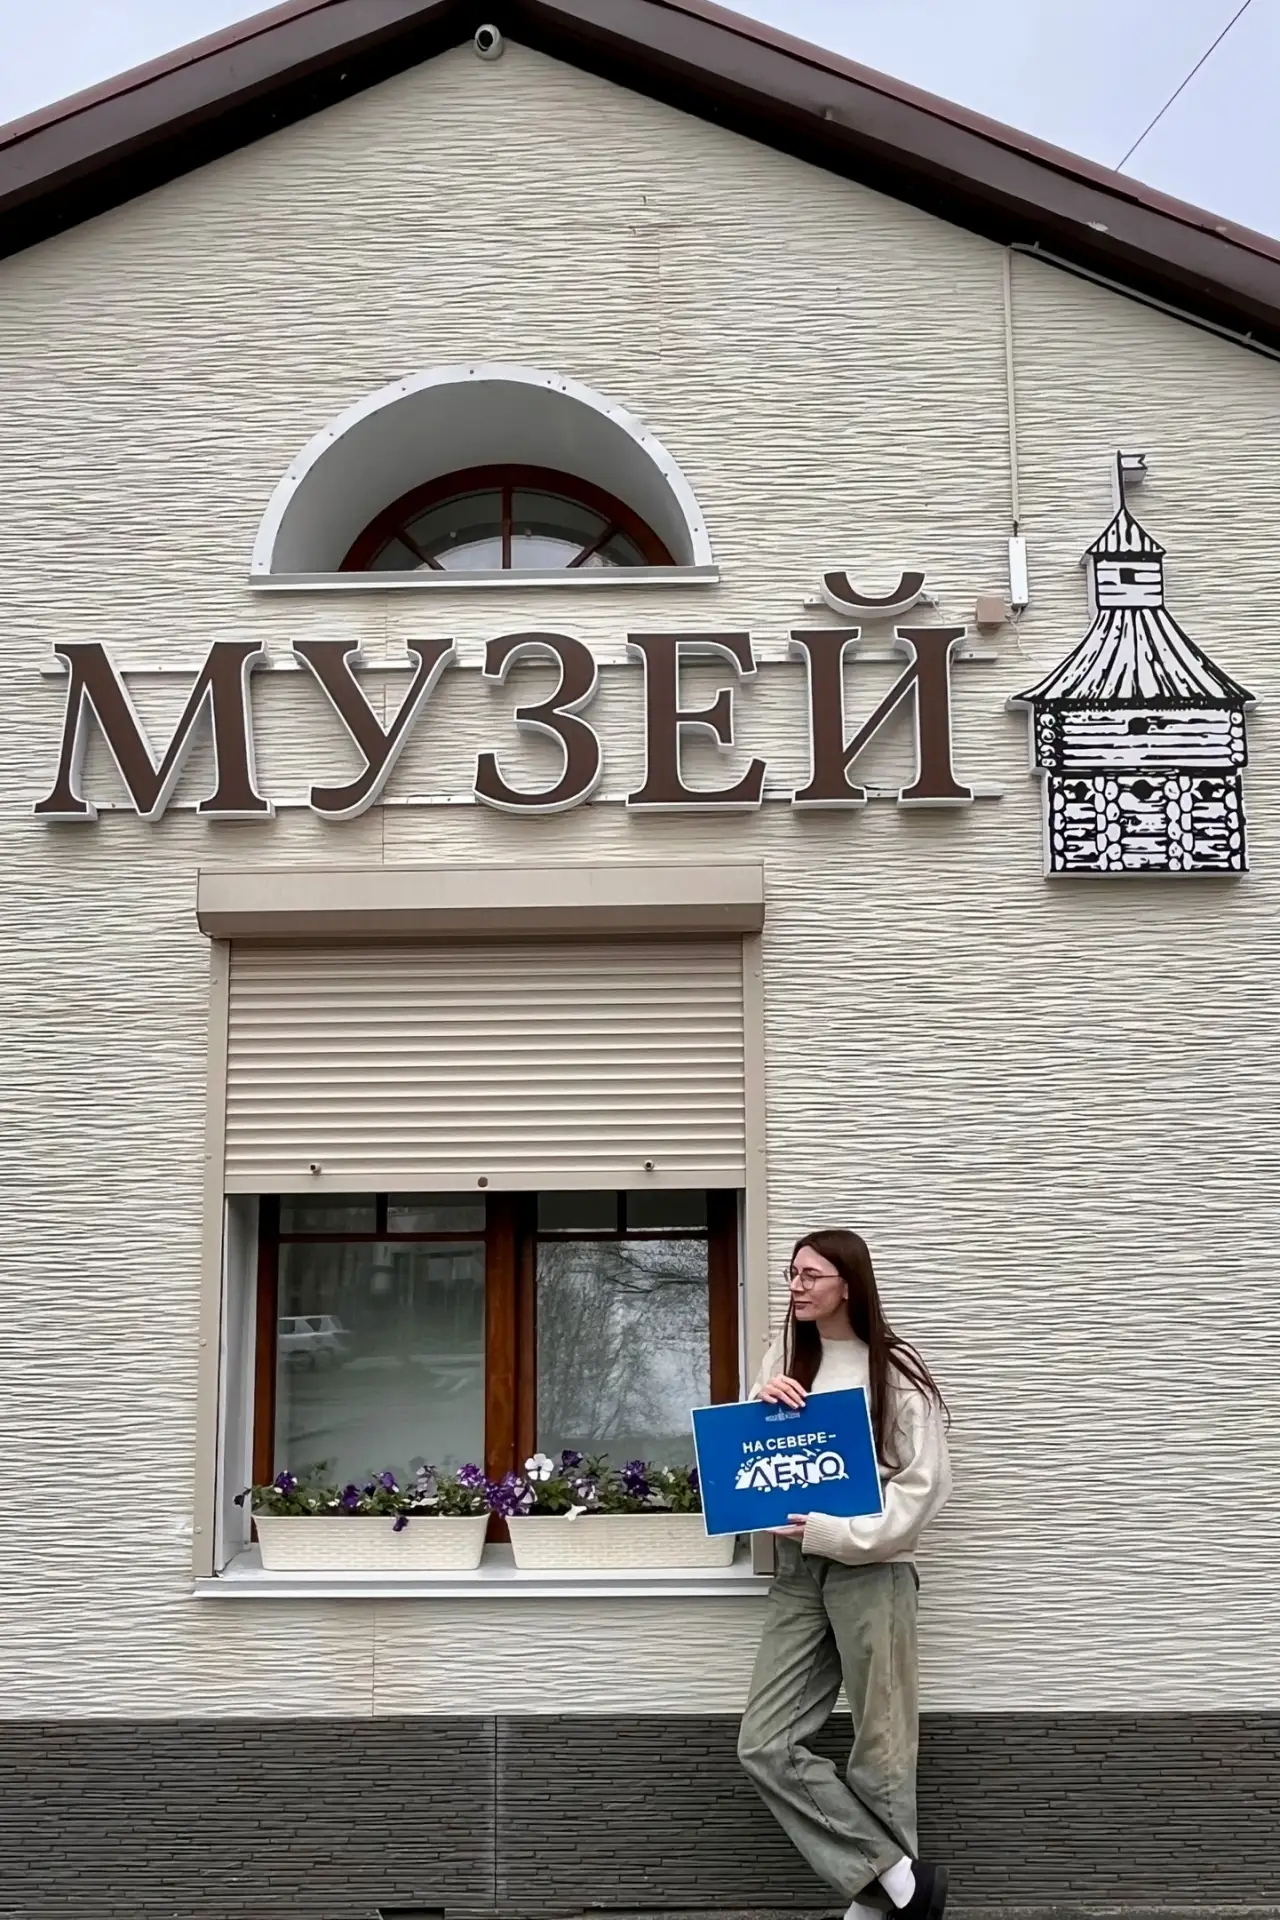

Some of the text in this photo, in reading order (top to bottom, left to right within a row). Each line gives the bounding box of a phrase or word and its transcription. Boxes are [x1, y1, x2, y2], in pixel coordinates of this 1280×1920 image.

[34, 571, 975, 820] МУЗЕЙ
[742, 1441, 764, 1454] НА
[747, 1452, 846, 1489] ЛЕТО
